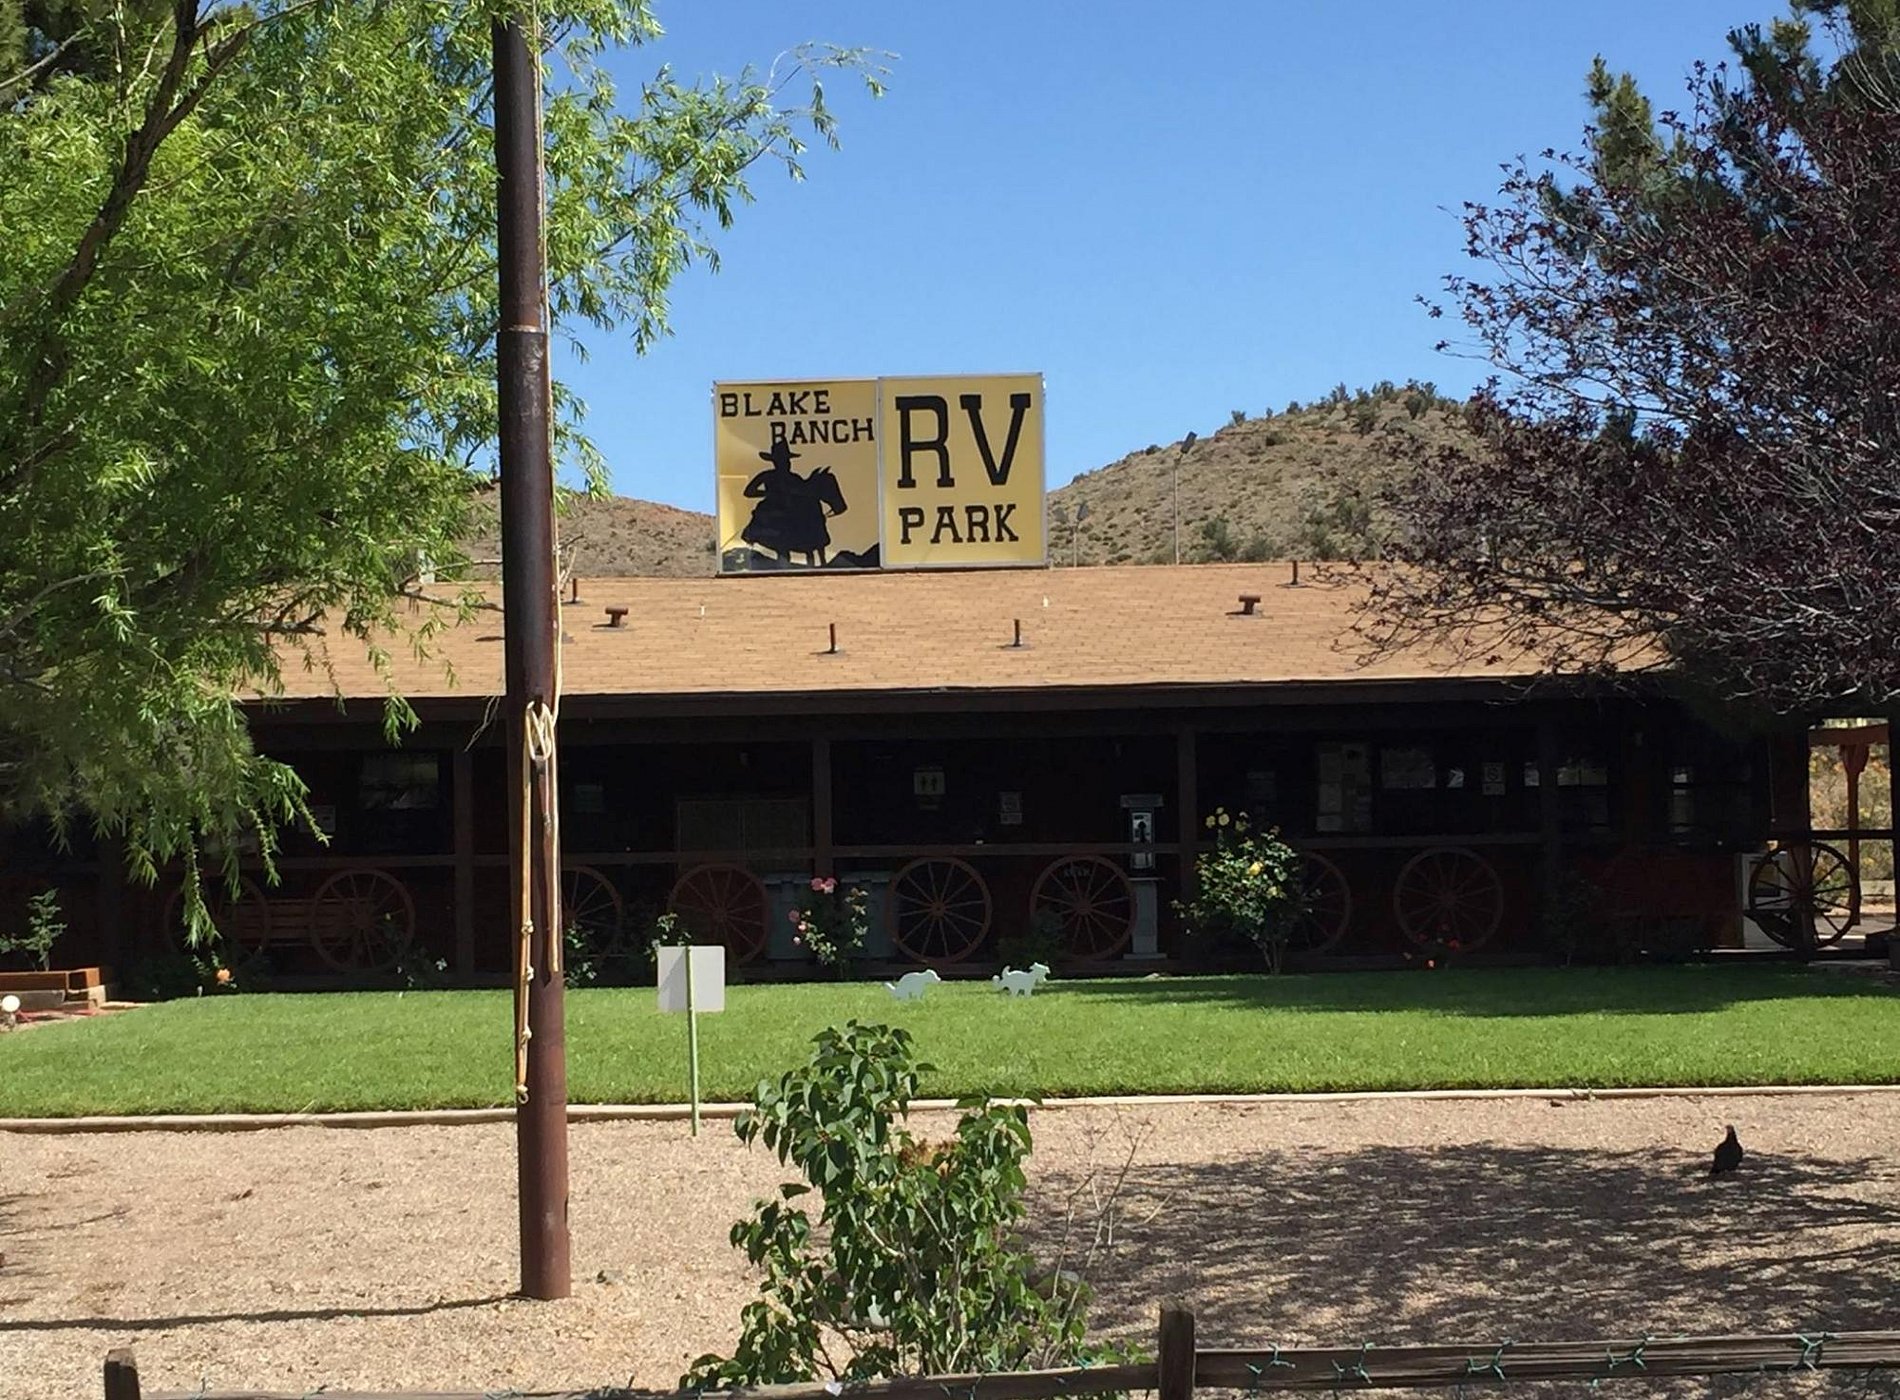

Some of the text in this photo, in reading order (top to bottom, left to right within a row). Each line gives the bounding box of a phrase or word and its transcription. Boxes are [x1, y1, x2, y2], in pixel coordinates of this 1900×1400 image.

[720, 389, 831, 418] BLAKE
[770, 417, 875, 445] RANCH
[895, 393, 1032, 489] RV
[898, 503, 1019, 545] PARK
